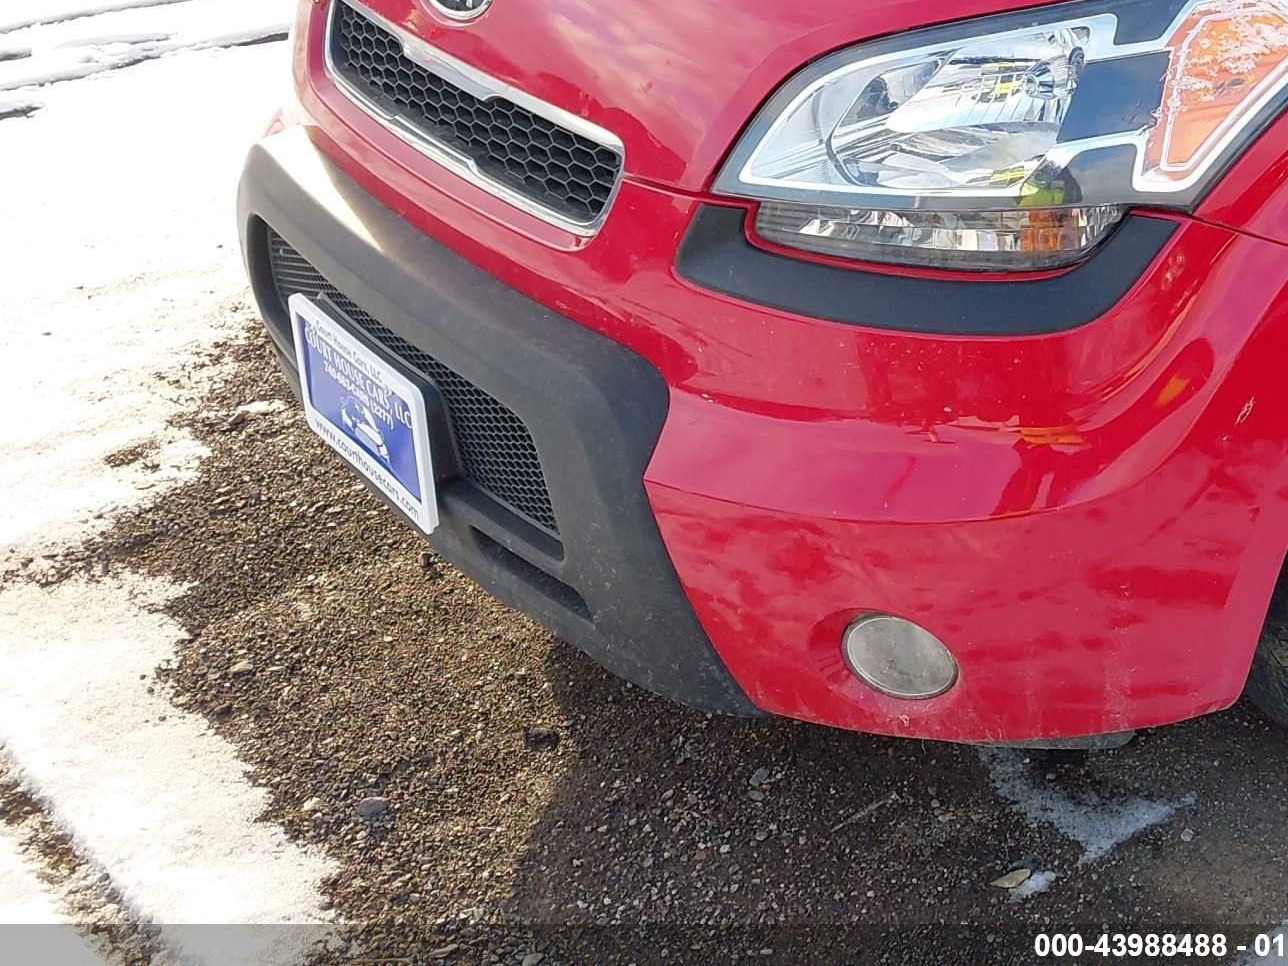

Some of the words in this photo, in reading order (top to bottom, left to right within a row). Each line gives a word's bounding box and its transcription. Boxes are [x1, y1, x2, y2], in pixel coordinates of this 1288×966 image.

[304, 325, 333, 364] COURT
[333, 350, 366, 390] HOUSE
[394, 401, 412, 430] LLC
